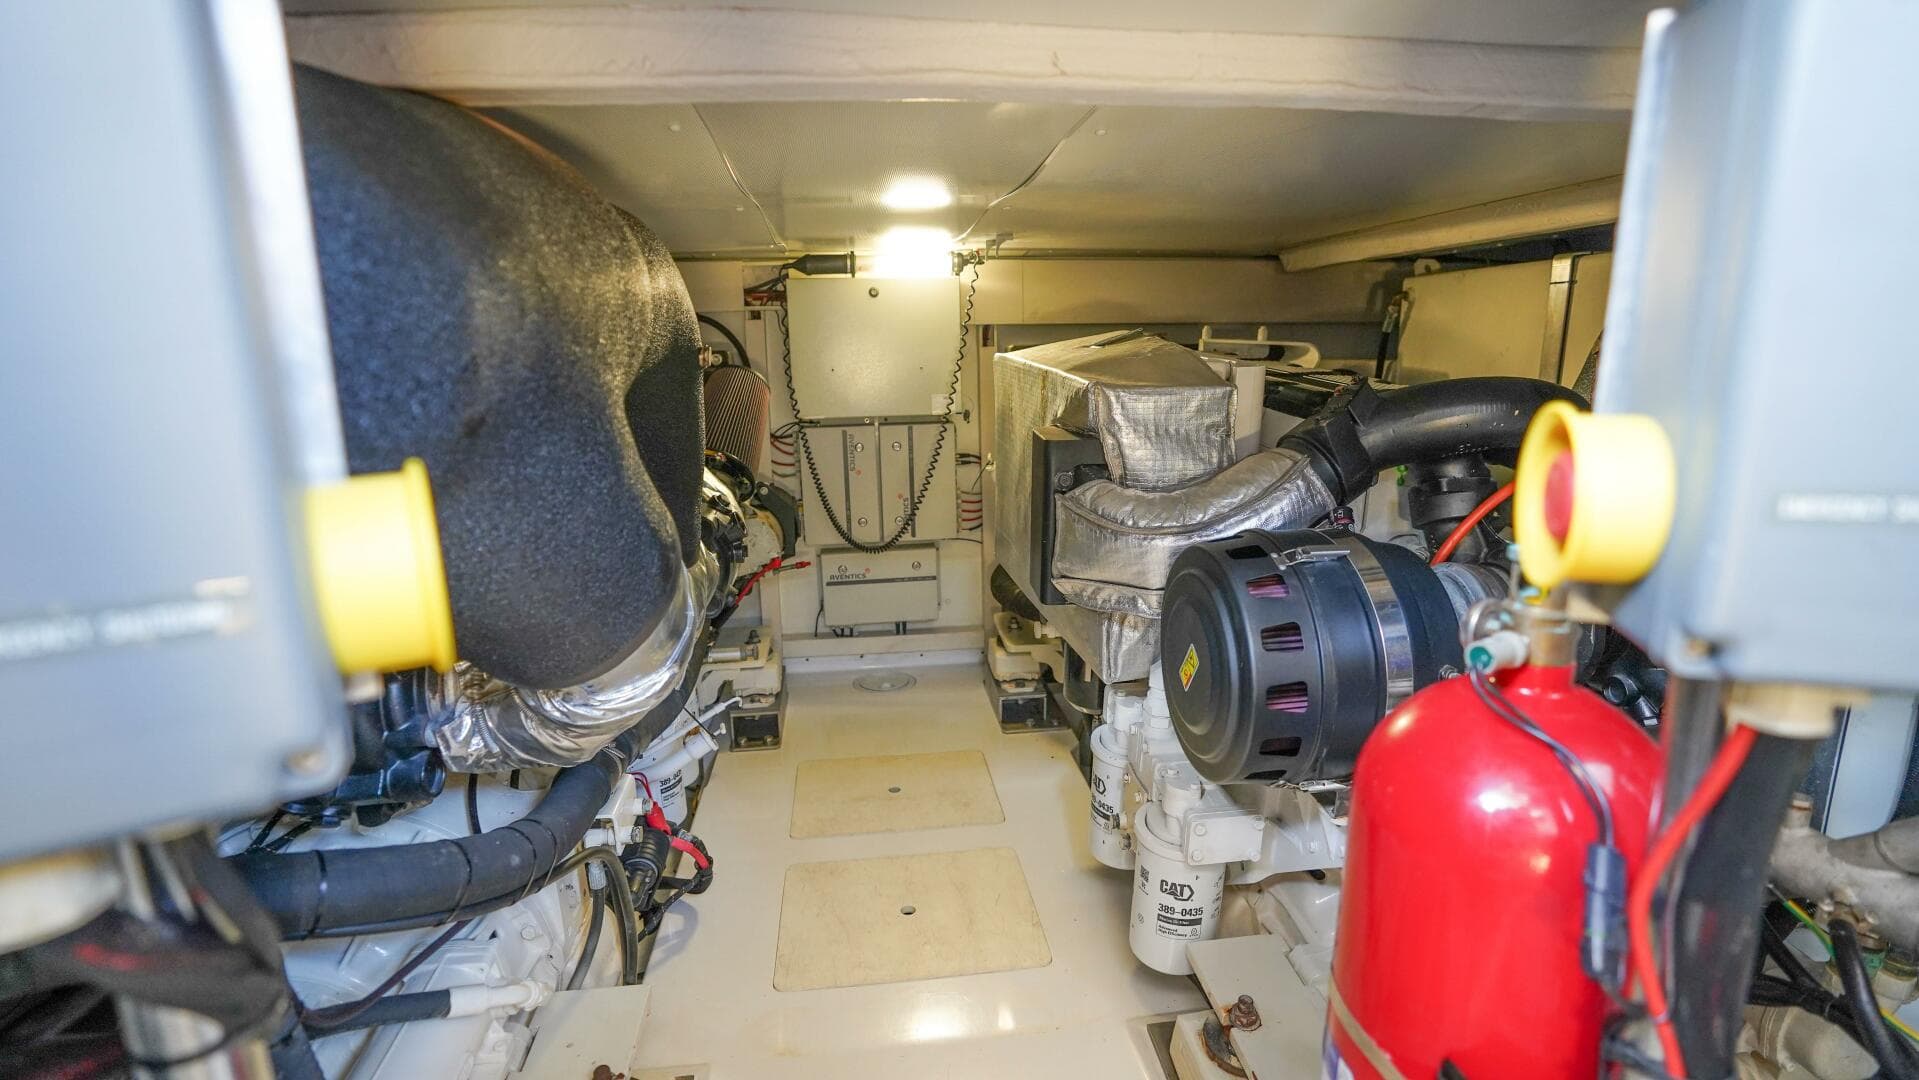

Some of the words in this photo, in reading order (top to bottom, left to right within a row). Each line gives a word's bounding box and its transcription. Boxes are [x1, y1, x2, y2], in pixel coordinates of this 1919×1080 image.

[829, 572, 867, 582] AVENTICS
[1160, 879, 1191, 900] CAT
[1158, 903, 1204, 917] 389-0435
